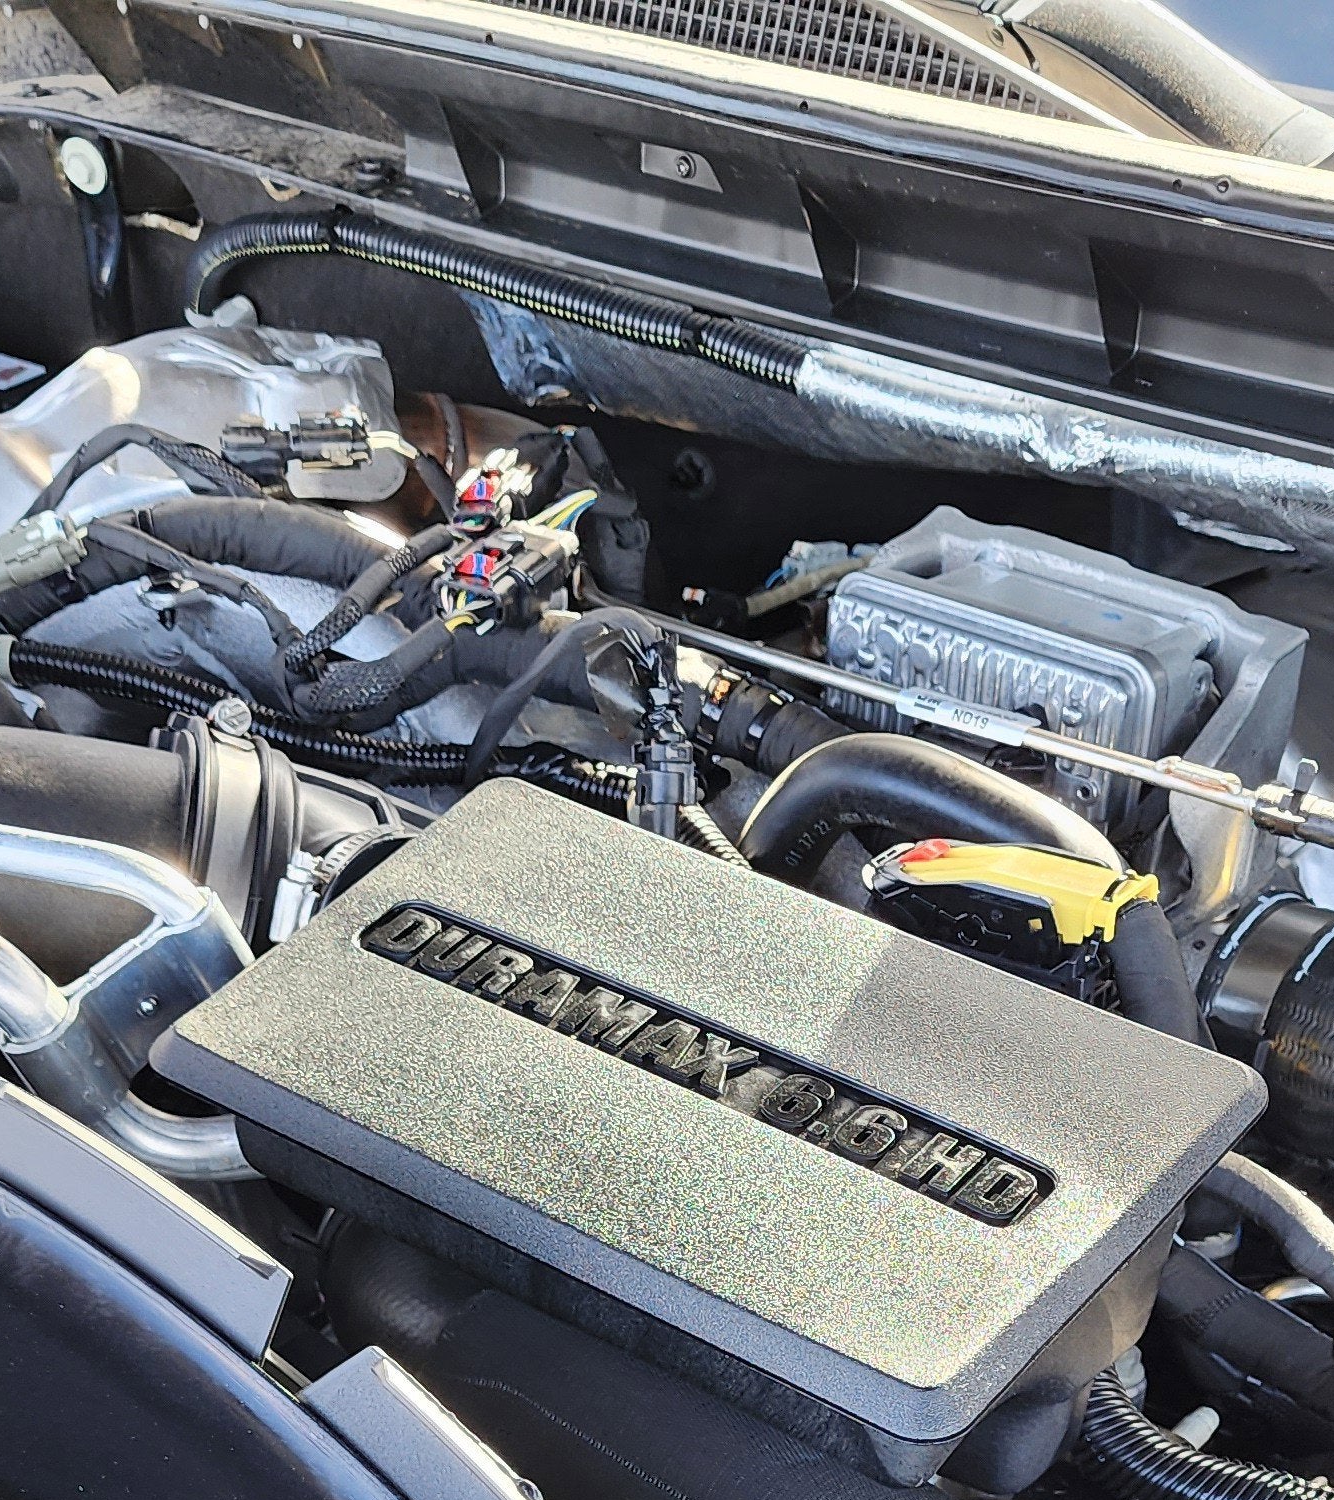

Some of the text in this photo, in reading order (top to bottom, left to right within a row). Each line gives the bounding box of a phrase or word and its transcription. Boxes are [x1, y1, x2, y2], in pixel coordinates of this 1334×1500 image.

[368, 907, 1040, 1220] DURAMAX 6.6 HD
